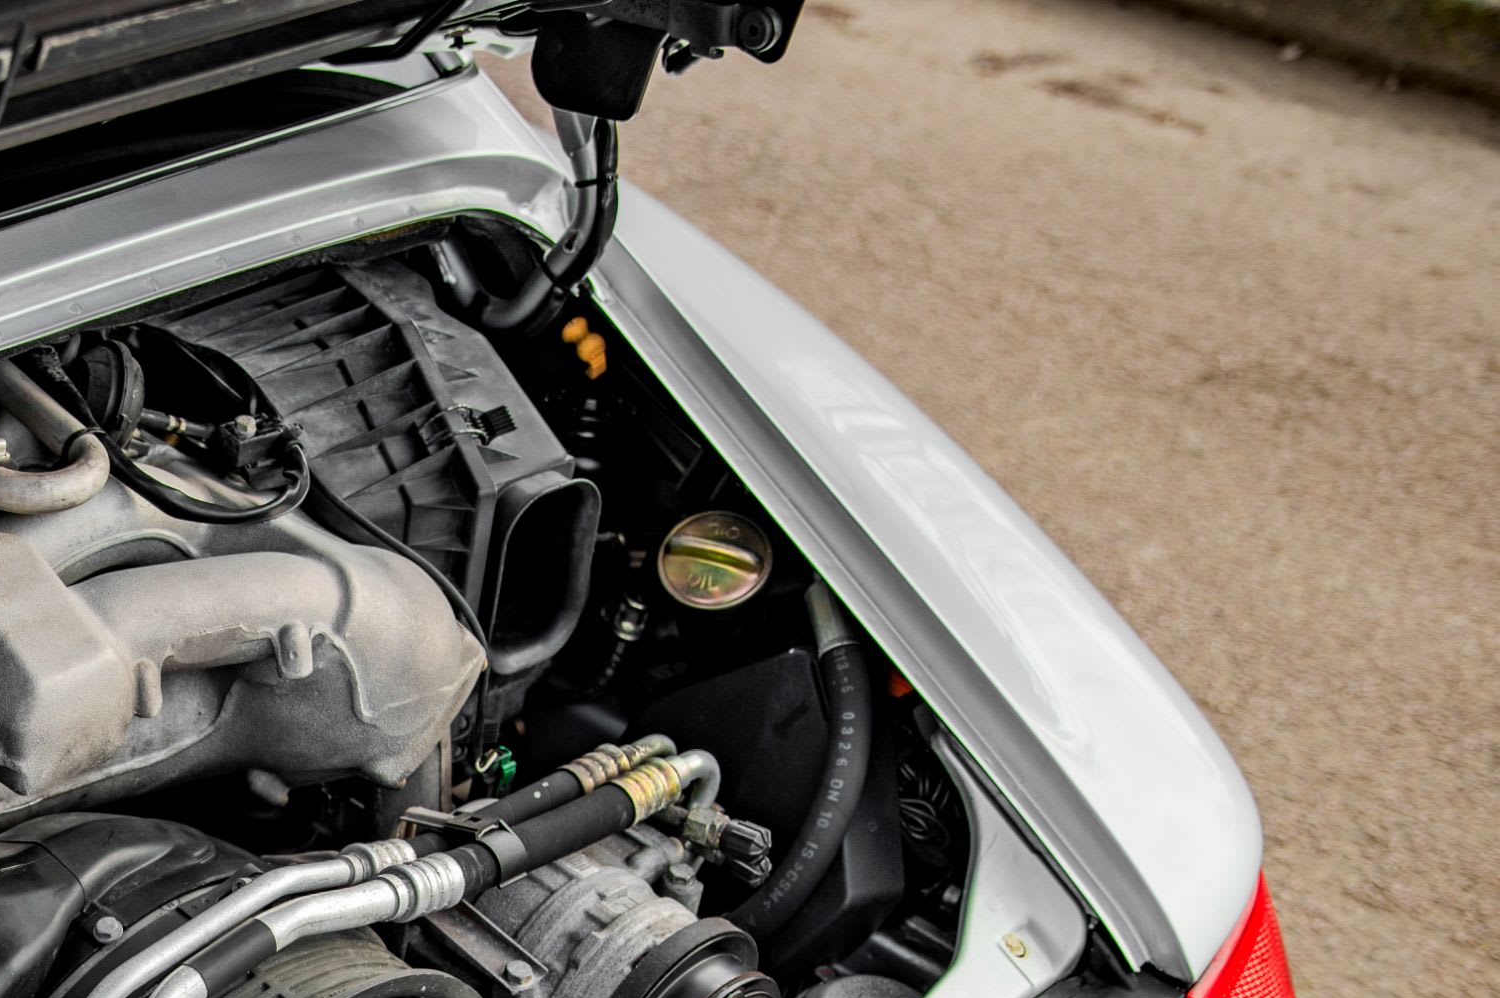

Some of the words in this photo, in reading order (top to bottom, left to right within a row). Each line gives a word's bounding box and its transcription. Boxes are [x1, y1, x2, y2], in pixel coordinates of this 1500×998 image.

[688, 569, 719, 591] OIL
[826, 778, 845, 804] DN
[816, 810, 833, 829] 10
